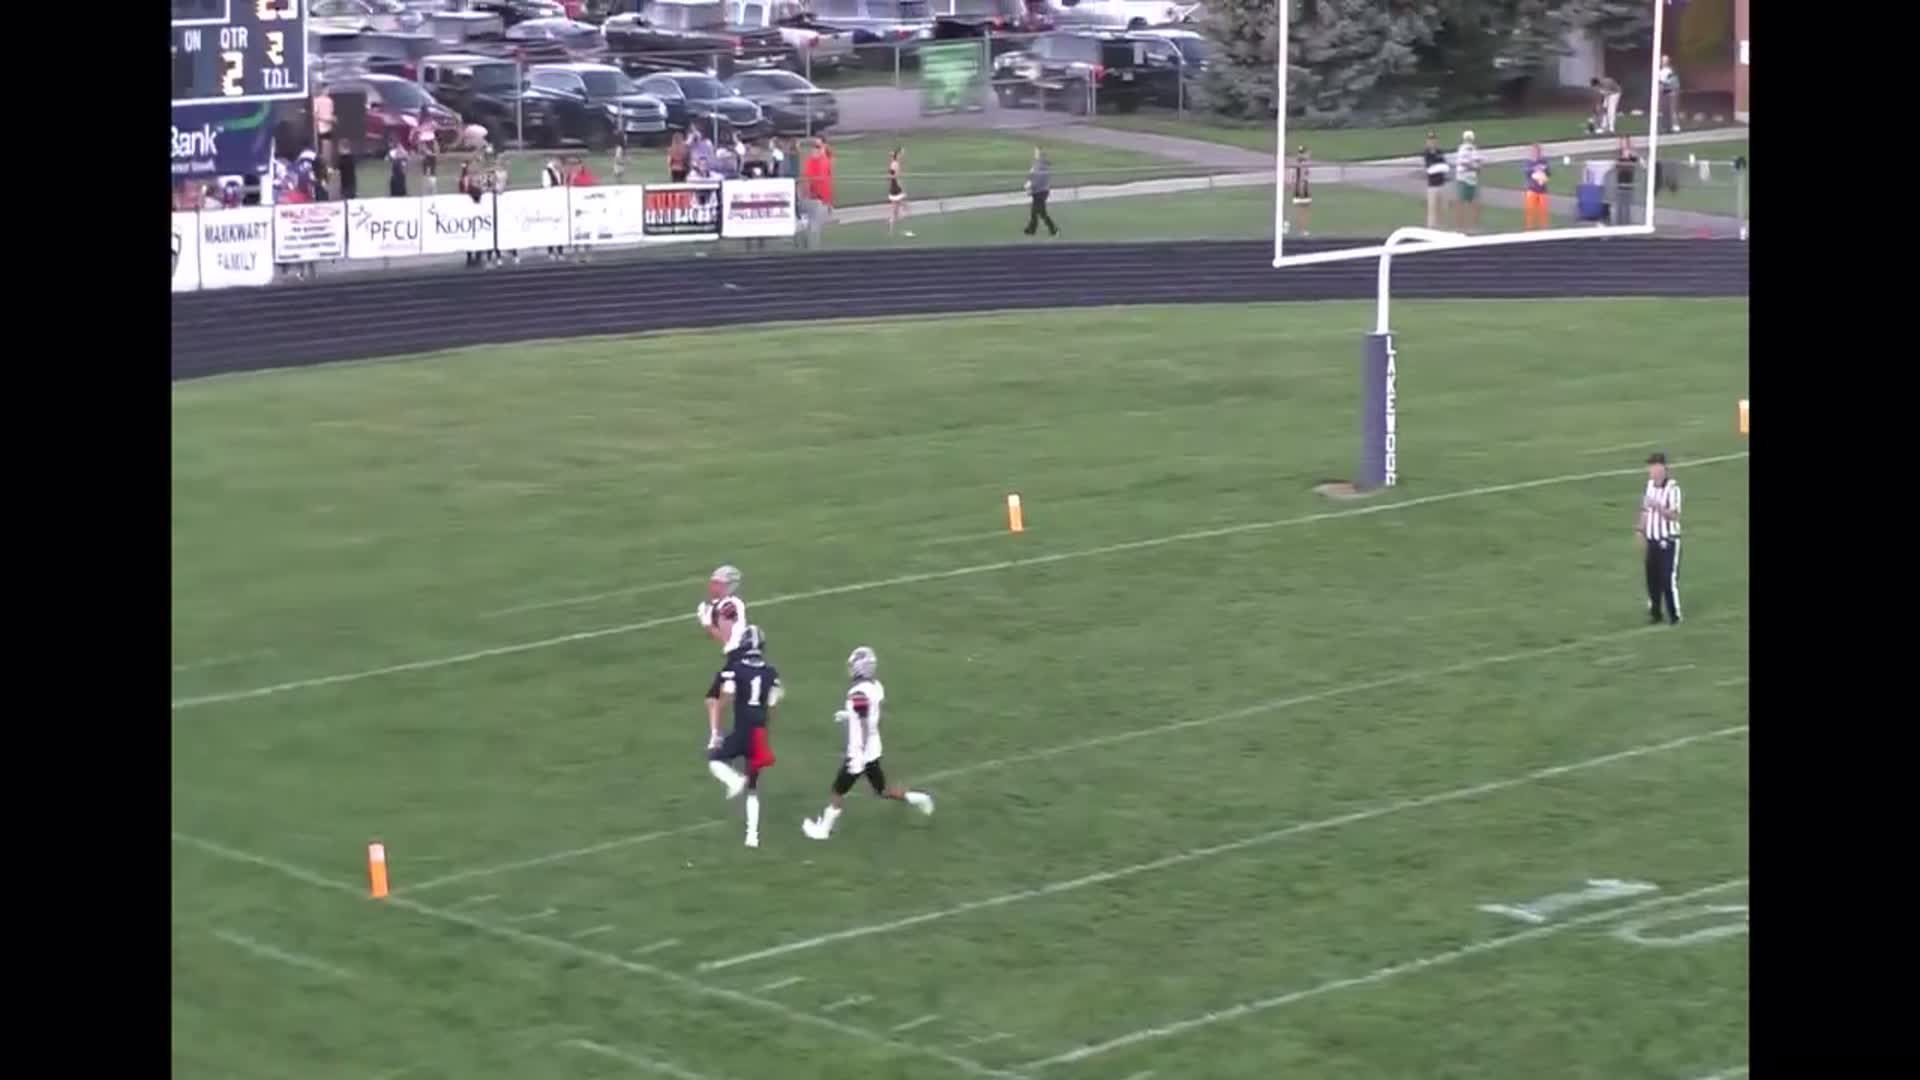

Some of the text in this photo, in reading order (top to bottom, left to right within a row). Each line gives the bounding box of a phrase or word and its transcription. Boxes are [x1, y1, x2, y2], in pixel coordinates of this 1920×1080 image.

[221, 51, 244, 96] 2
[370, 219, 418, 241] PFCU
[217, 251, 257, 271] FAMILY
[748, 675, 762, 706] 1
